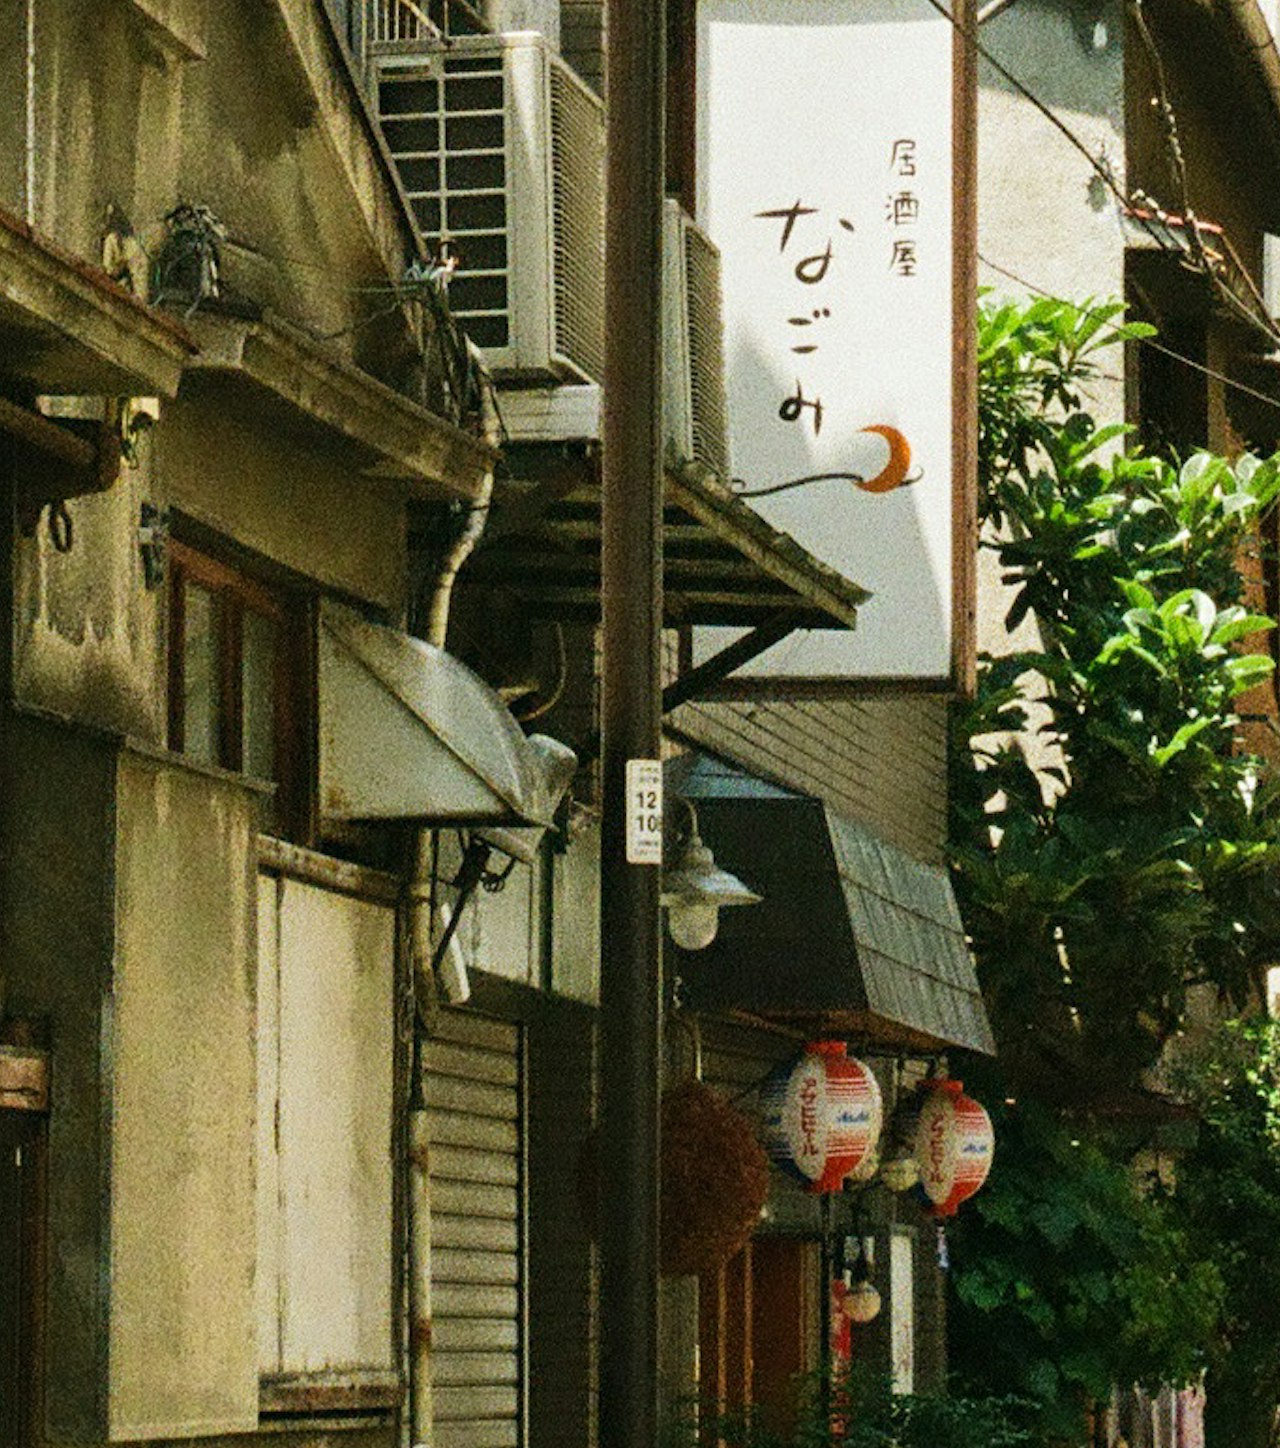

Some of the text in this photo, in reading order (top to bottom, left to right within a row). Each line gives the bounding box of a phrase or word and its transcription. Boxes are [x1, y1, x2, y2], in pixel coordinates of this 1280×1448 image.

[885, 137, 921, 278] 居酒屋
[754, 197, 857, 440] なごみ
[635, 814, 658, 833] 10
[636, 790, 658, 810] 12
